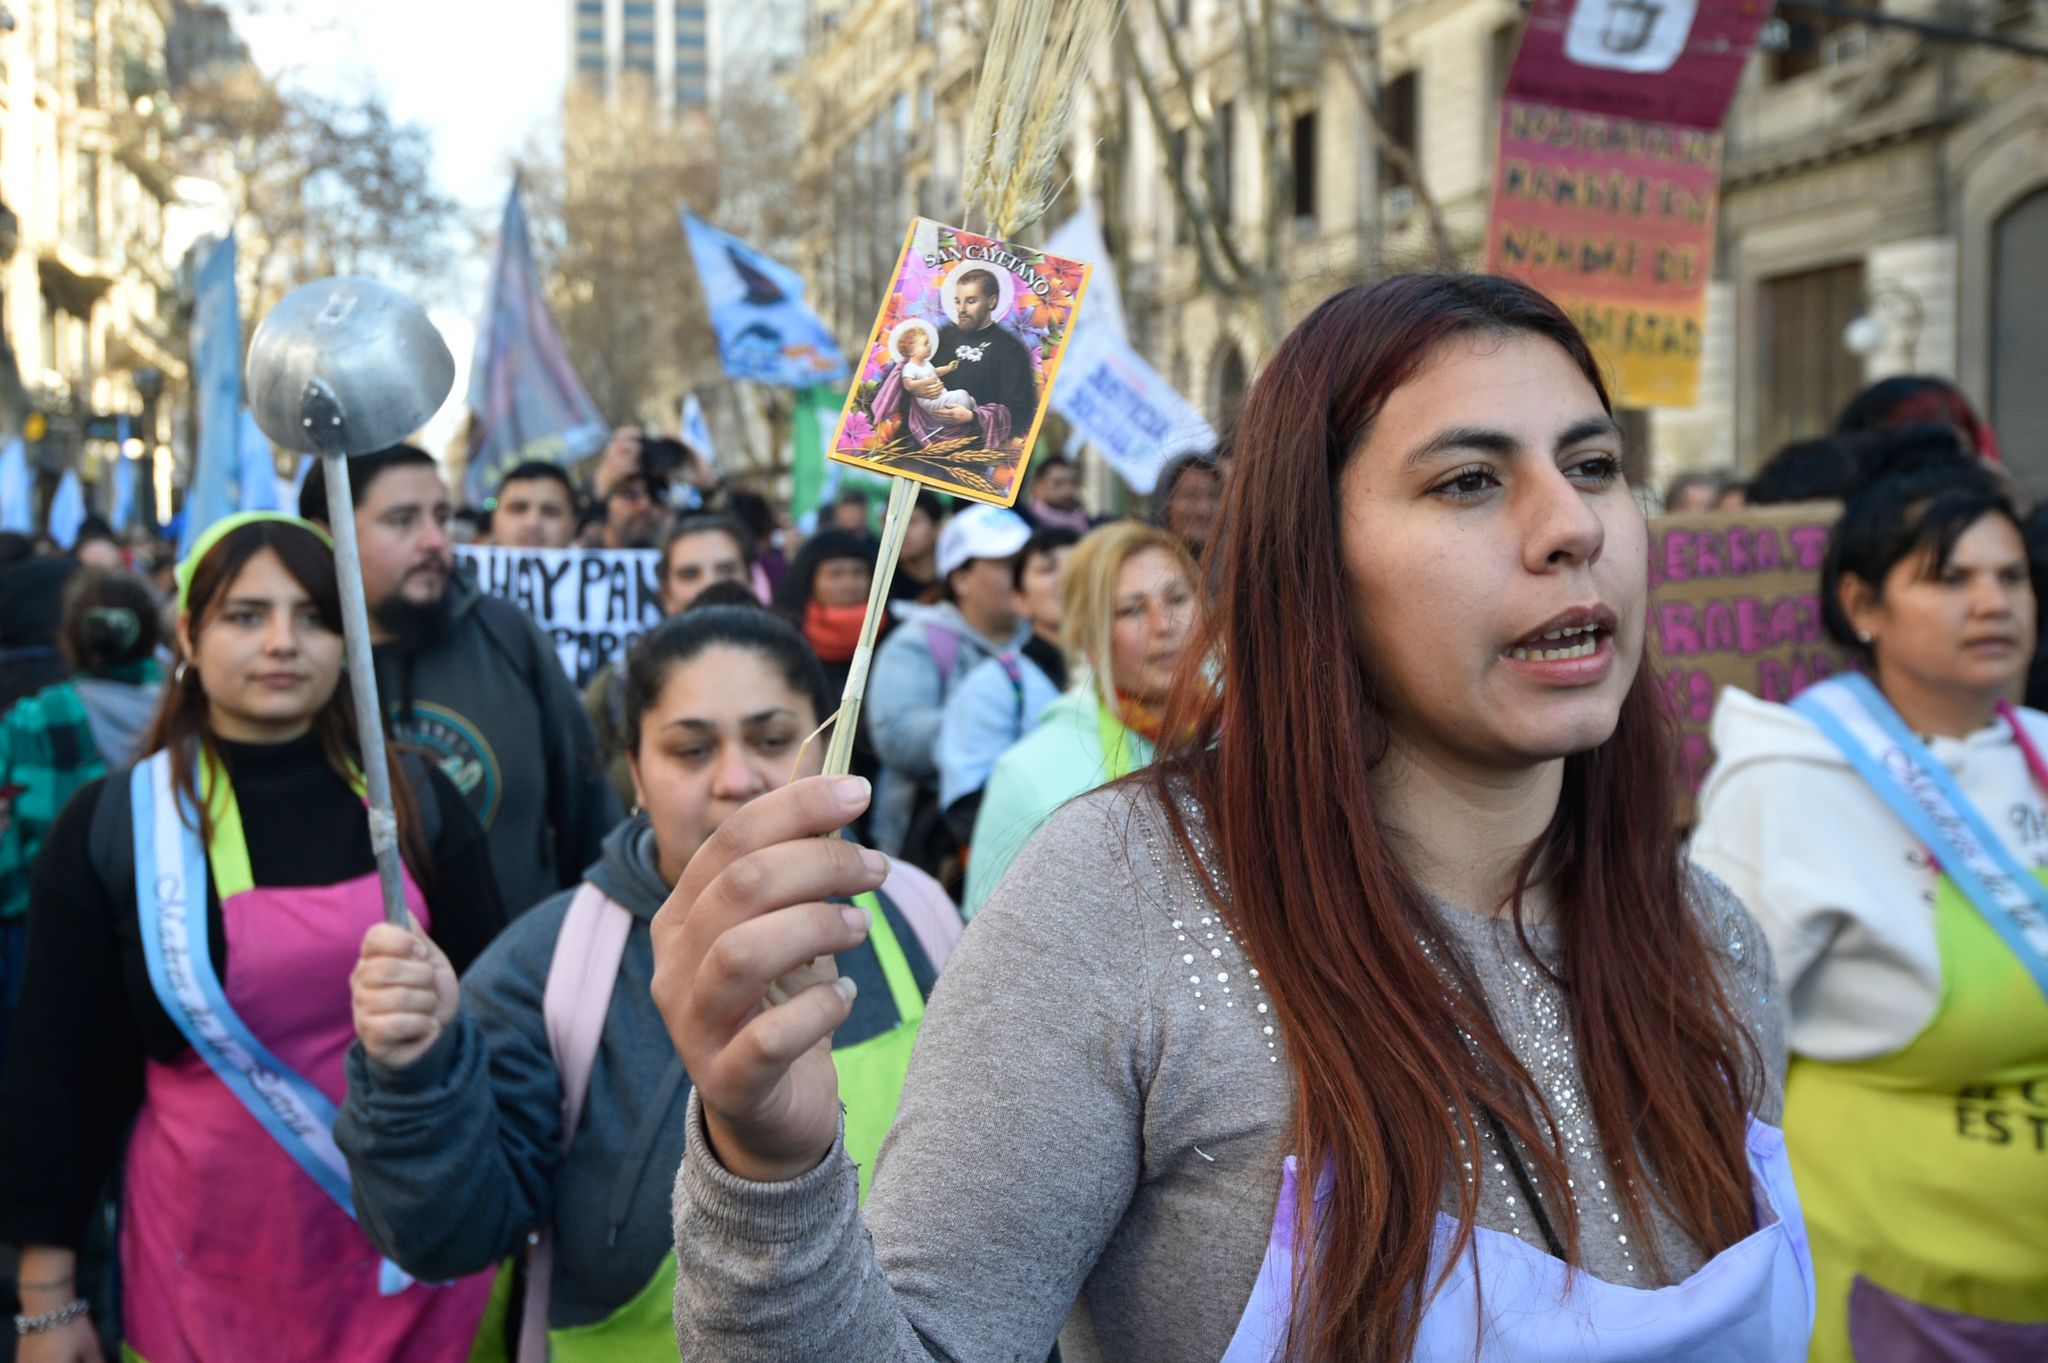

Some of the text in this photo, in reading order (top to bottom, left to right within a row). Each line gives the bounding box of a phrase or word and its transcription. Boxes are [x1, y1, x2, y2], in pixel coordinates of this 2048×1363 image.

[923, 245, 1050, 296] SAN CAYETANO
[1955, 1106, 2011, 1146] ES
